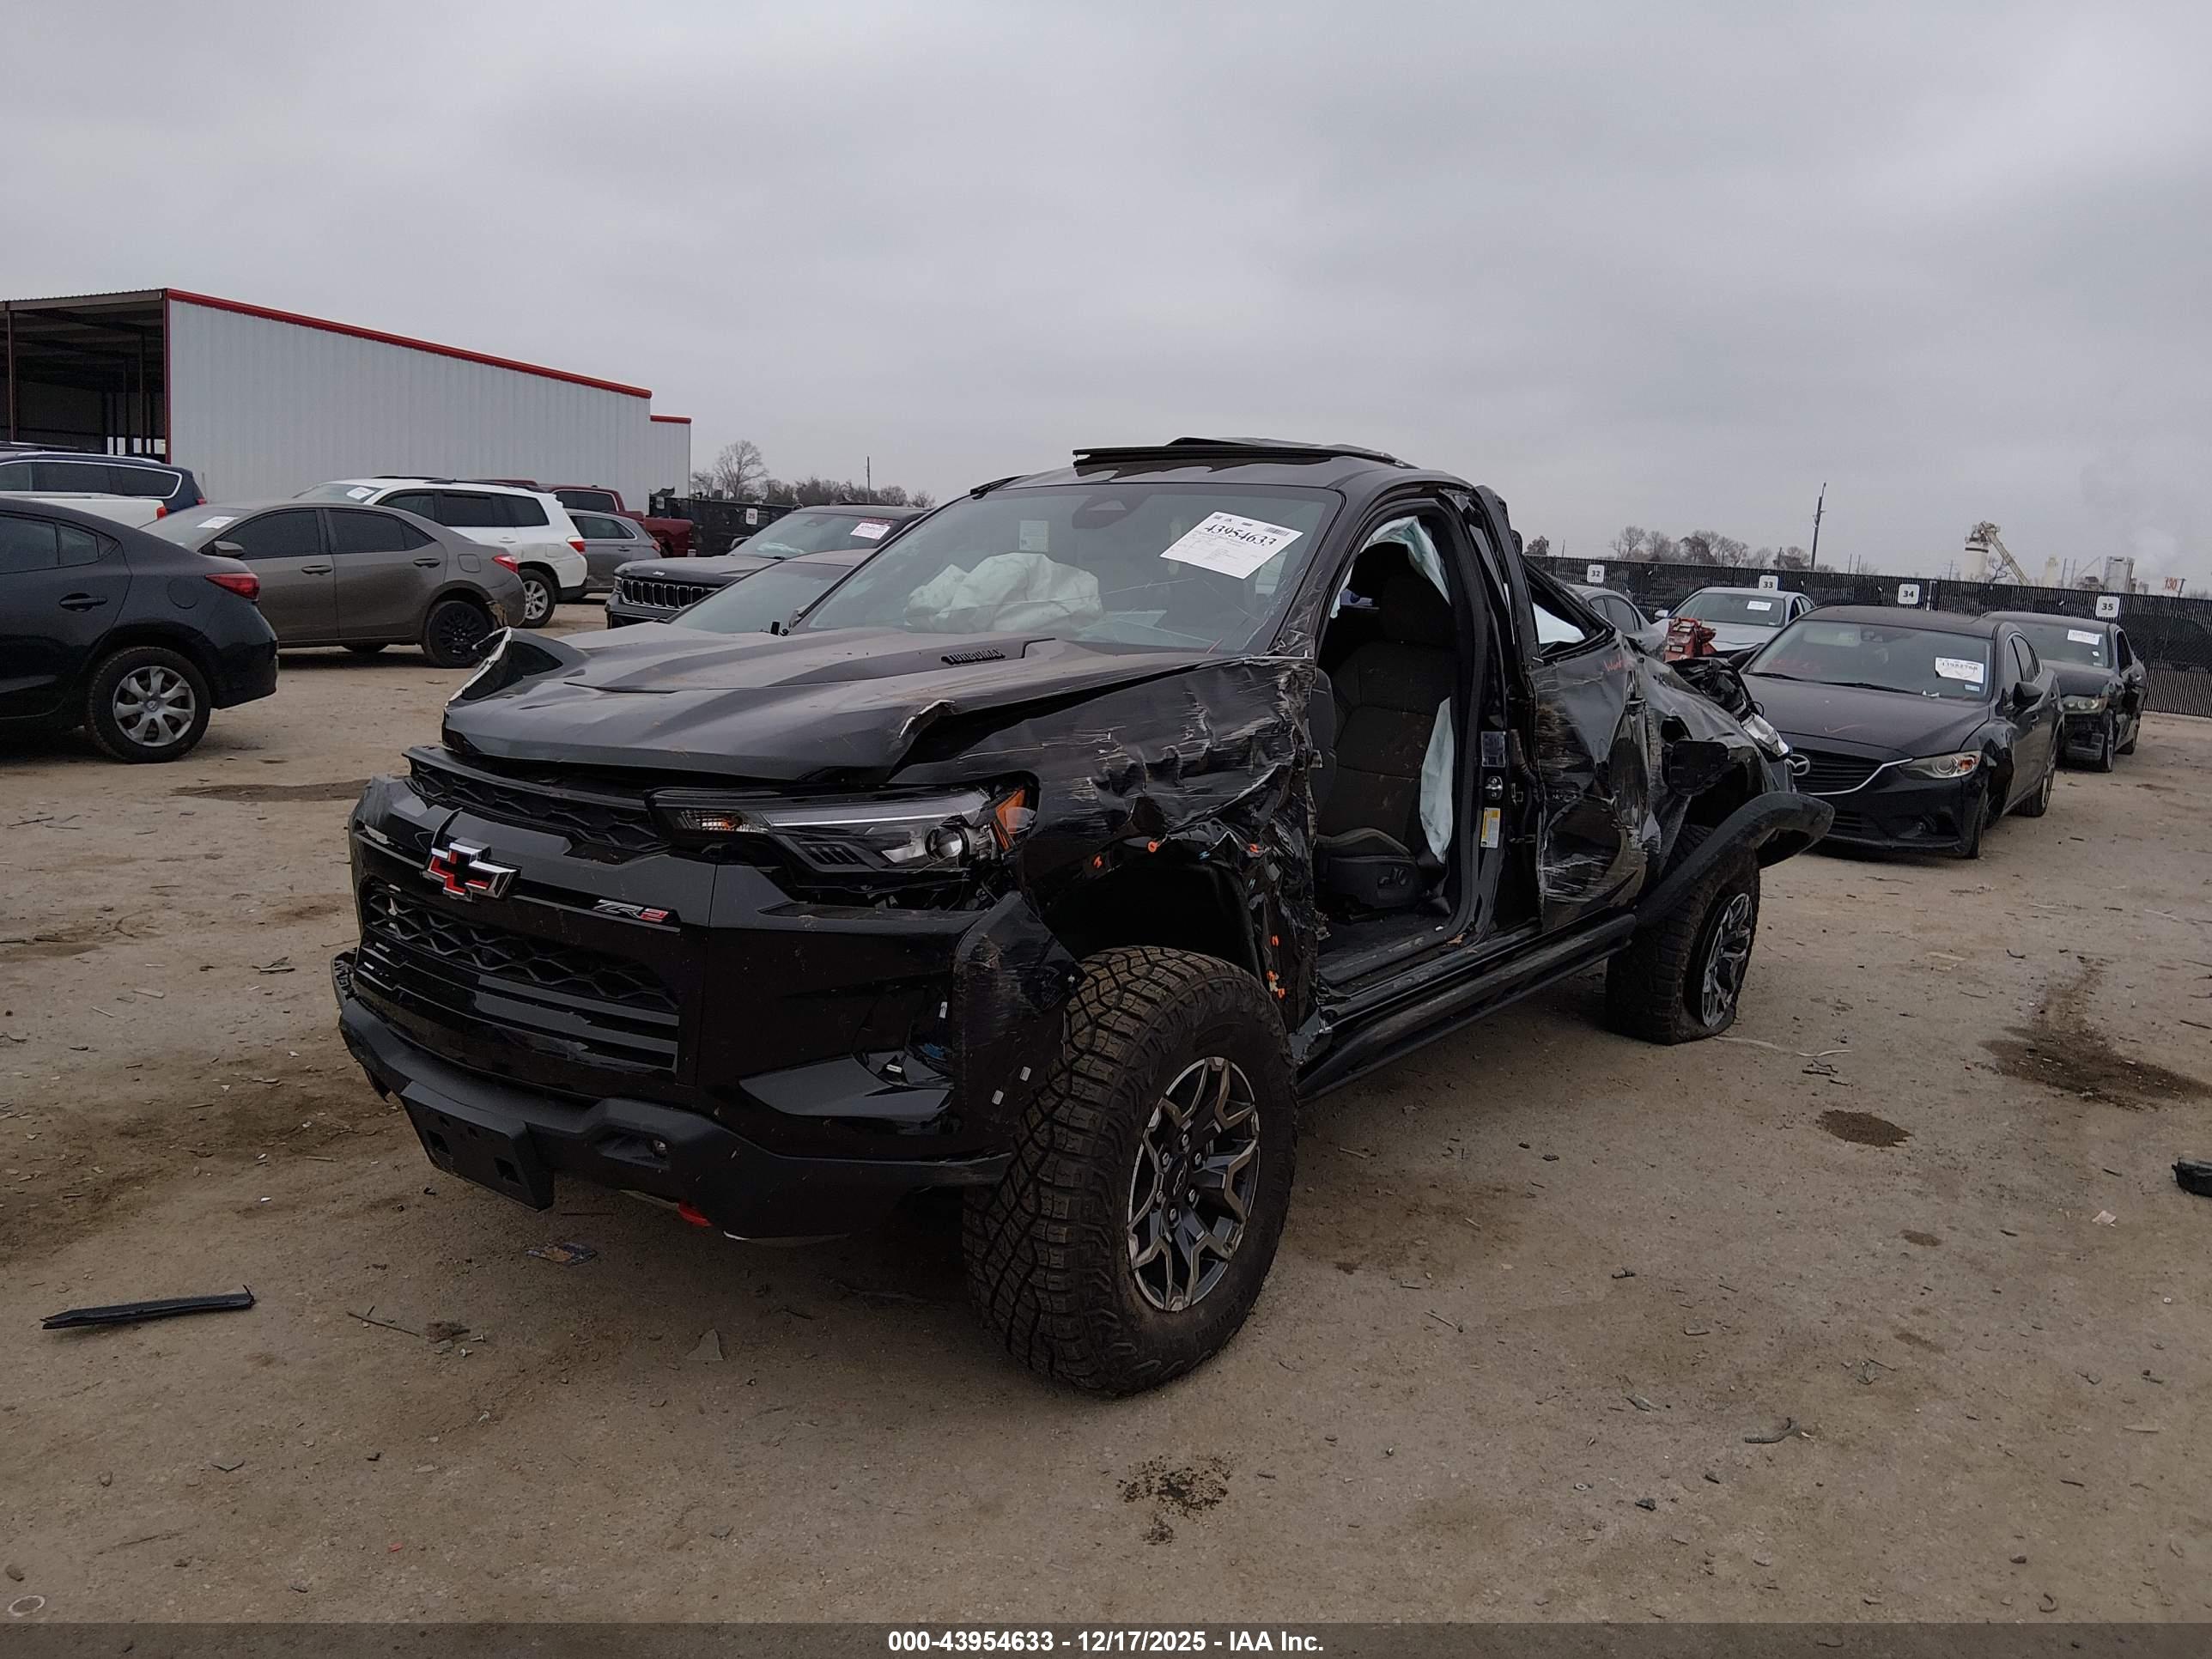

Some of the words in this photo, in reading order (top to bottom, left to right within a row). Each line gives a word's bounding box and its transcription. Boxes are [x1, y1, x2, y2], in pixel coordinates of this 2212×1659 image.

[1204, 523, 1278, 547] 43954633
[1762, 580, 1774, 589] 33
[1902, 590, 1915, 599] 34
[2100, 602, 2115, 612] 35
[941, 647, 1006, 665] TURBOMAX
[592, 898, 670, 923] ZR2
